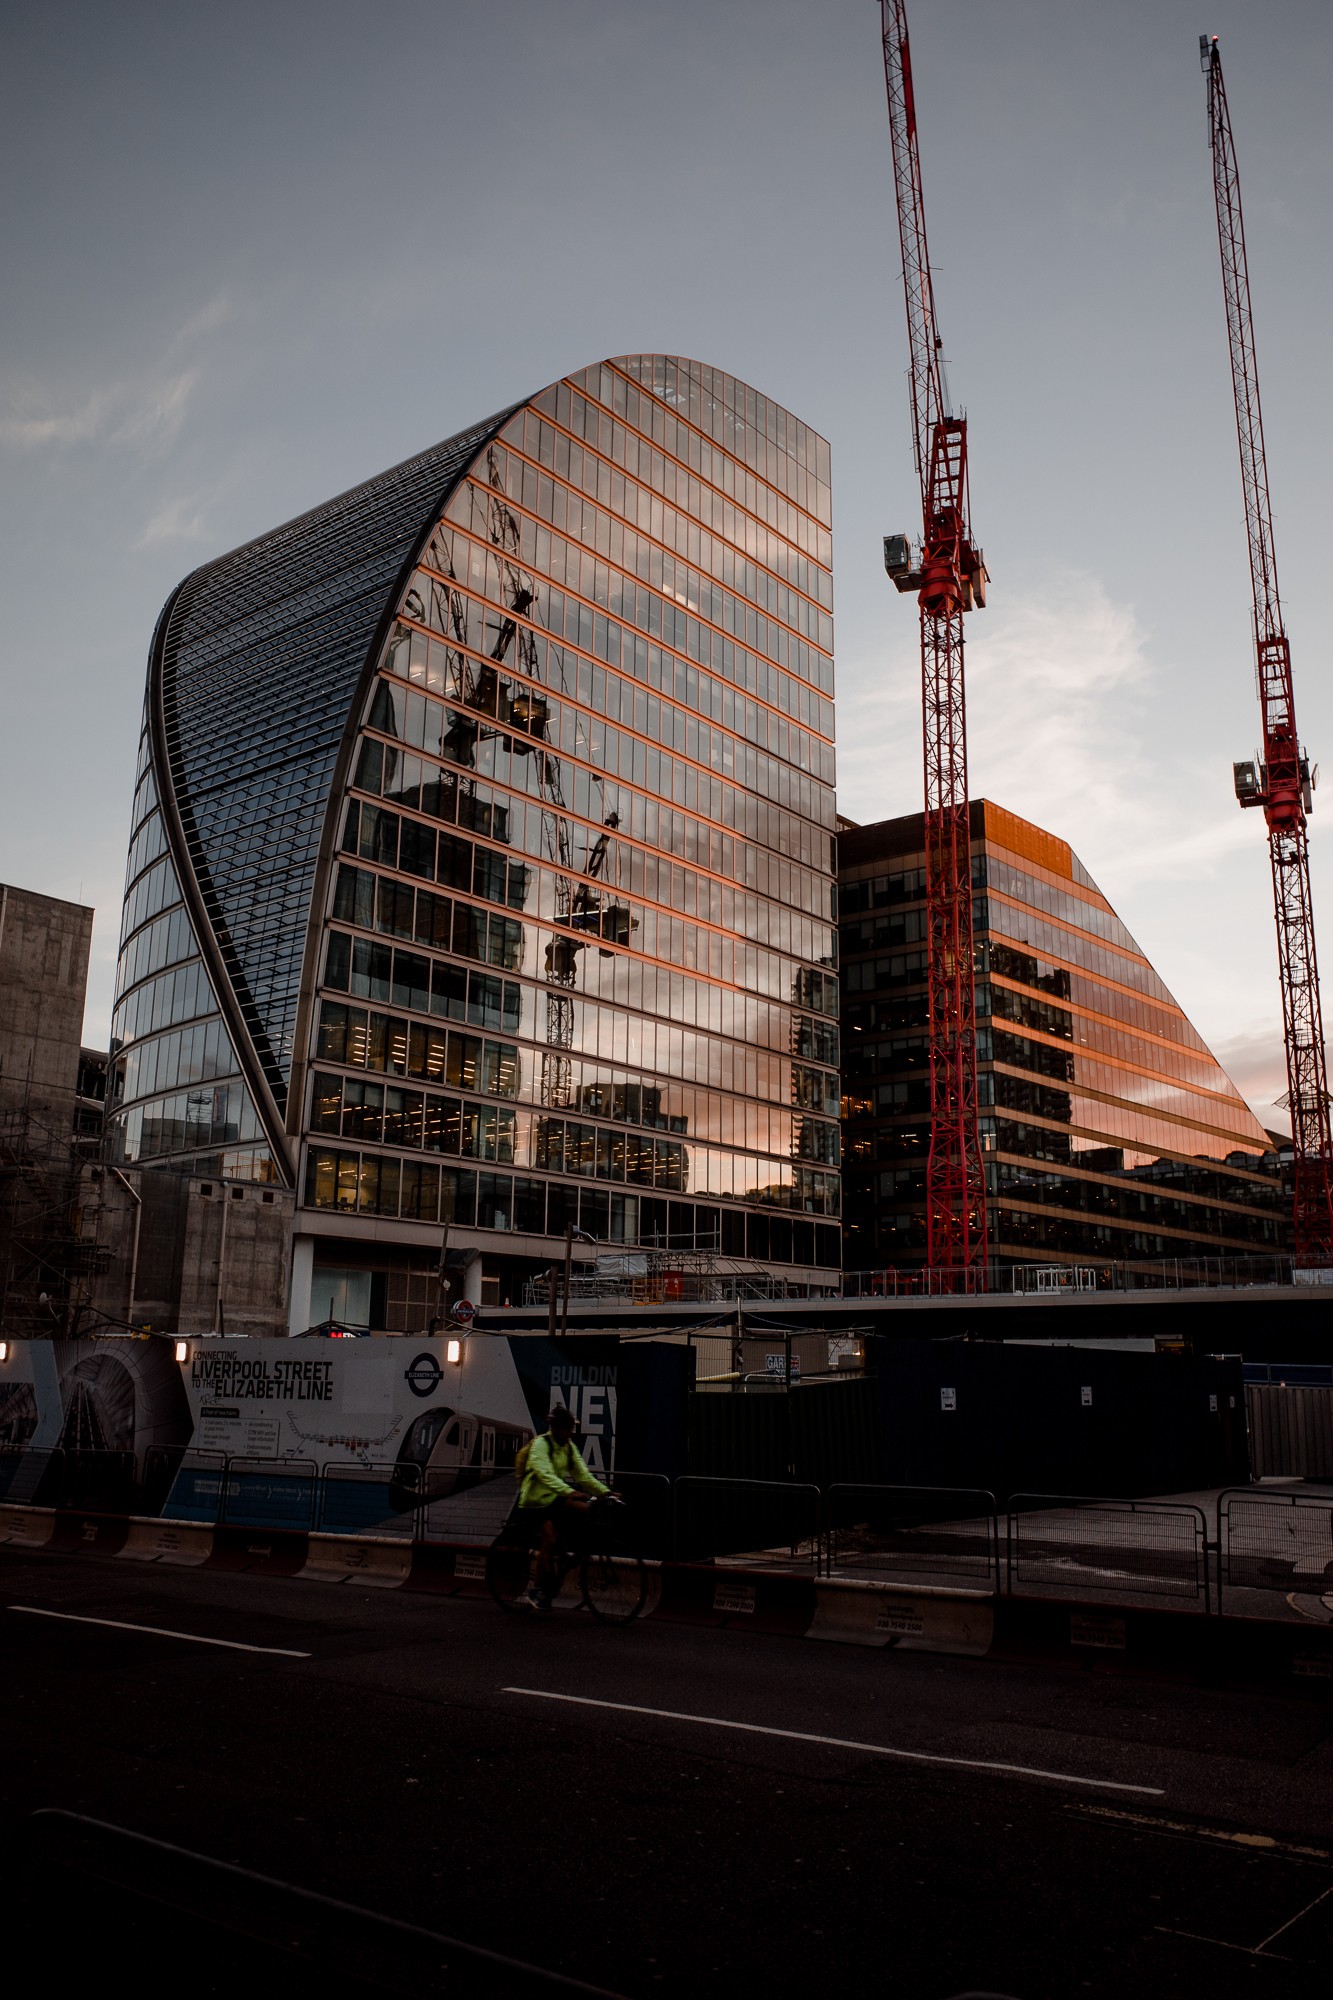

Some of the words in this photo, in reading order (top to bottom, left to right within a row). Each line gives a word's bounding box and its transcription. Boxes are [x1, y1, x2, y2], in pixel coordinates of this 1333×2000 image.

[193, 1351, 237, 1360] CONNECTING
[192, 1361, 270, 1380] LIVERPOOL
[274, 1361, 333, 1380] STREET
[551, 1366, 618, 1385] BUILDIN
[192, 1379, 200, 1388] TO
[202, 1379, 215, 1389] THE
[214, 1379, 294, 1399] ELIZABETH
[298, 1381, 333, 1400] LINE
[549, 1385, 618, 1435] NE
